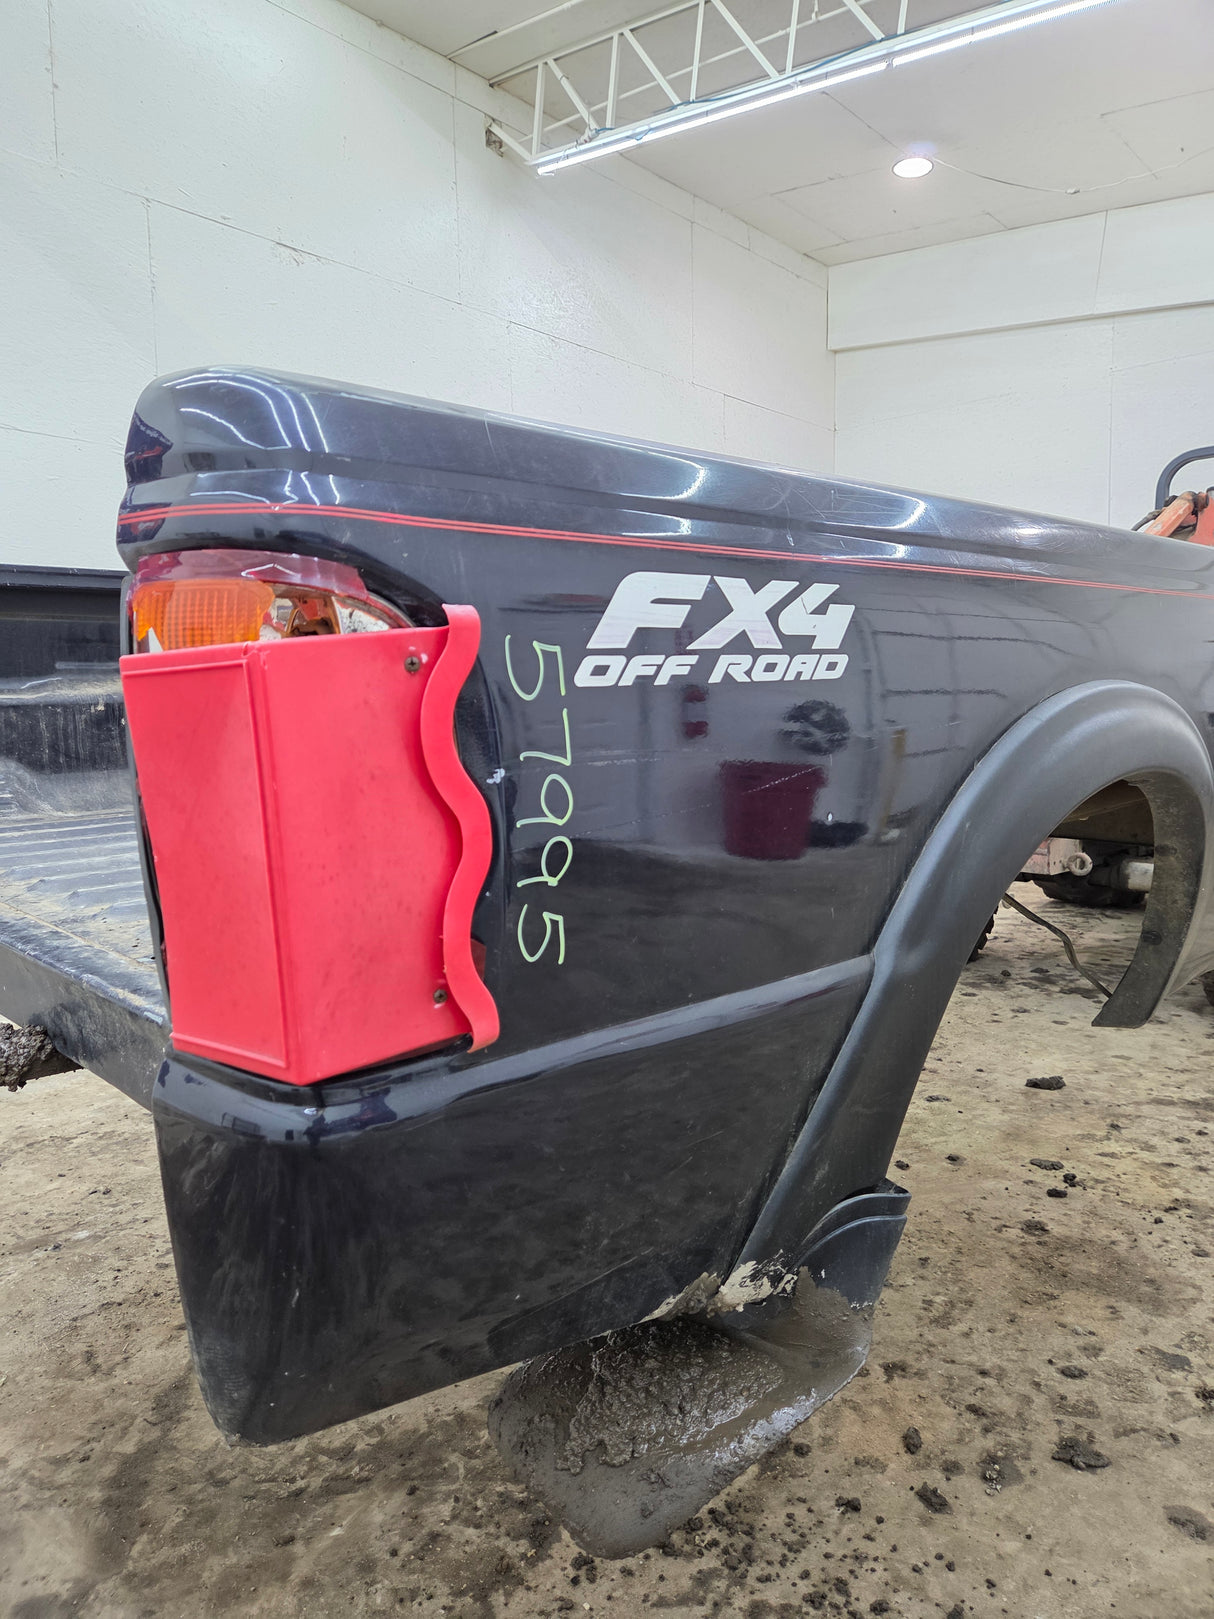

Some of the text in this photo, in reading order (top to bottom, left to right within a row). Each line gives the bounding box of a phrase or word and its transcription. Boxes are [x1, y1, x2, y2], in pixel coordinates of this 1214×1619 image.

[586, 571, 856, 649] FX4
[573, 653, 850, 687] OFF ROAD
[504, 634, 574, 966] 57995
